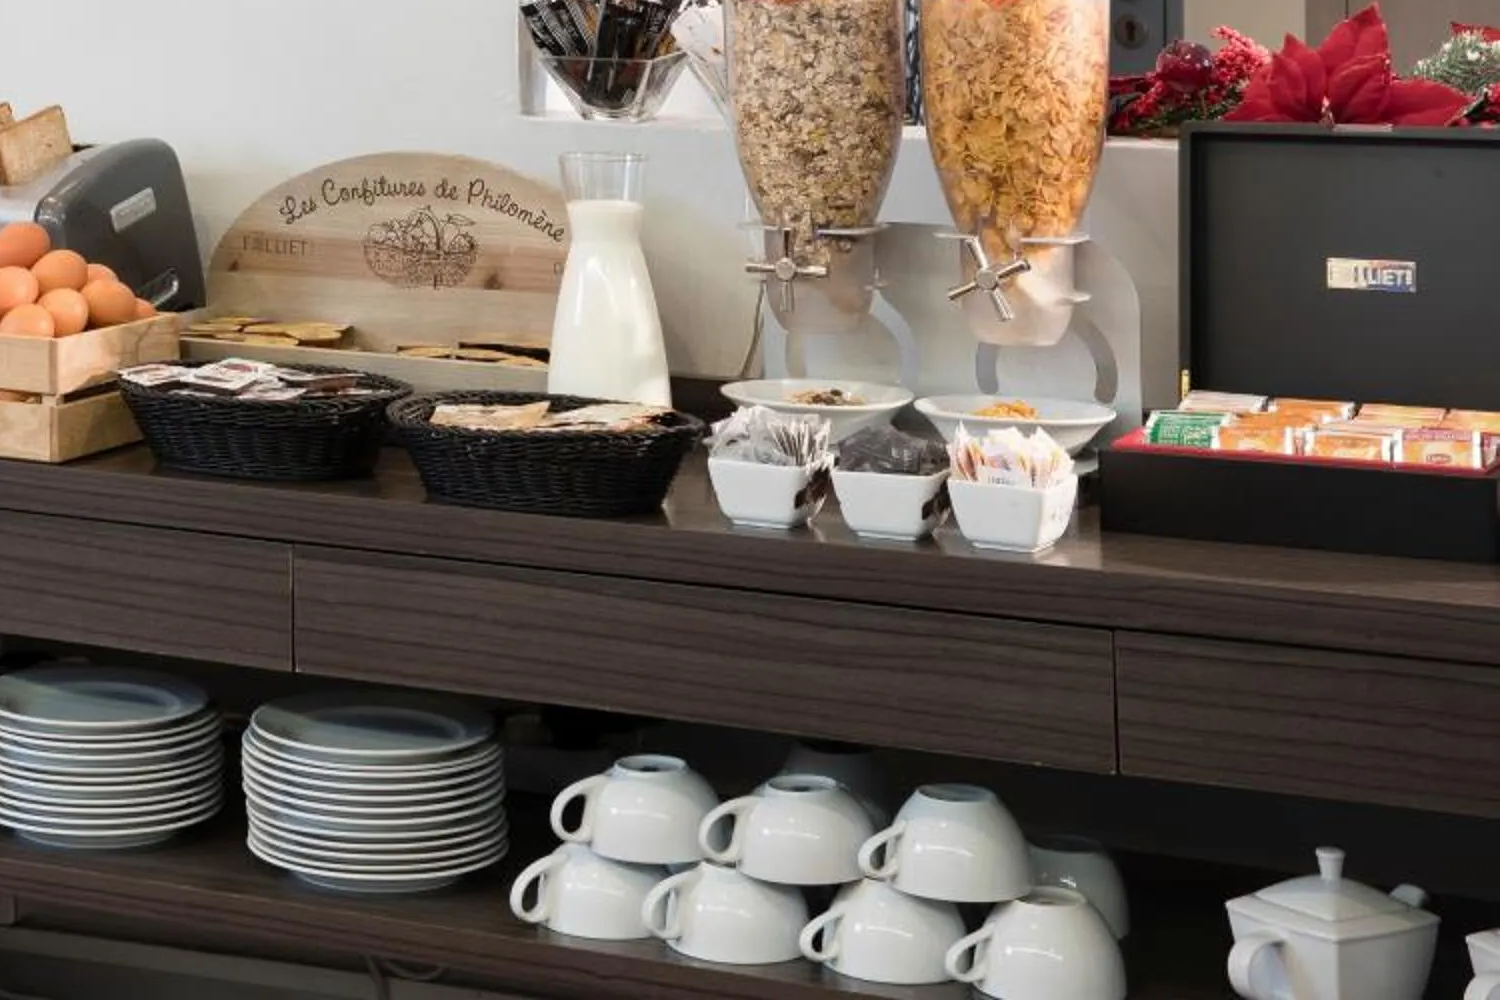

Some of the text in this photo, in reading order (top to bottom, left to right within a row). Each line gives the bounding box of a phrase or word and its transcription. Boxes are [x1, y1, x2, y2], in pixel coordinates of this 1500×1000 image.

[279, 176, 566, 243] Les Confitures de Philomène
